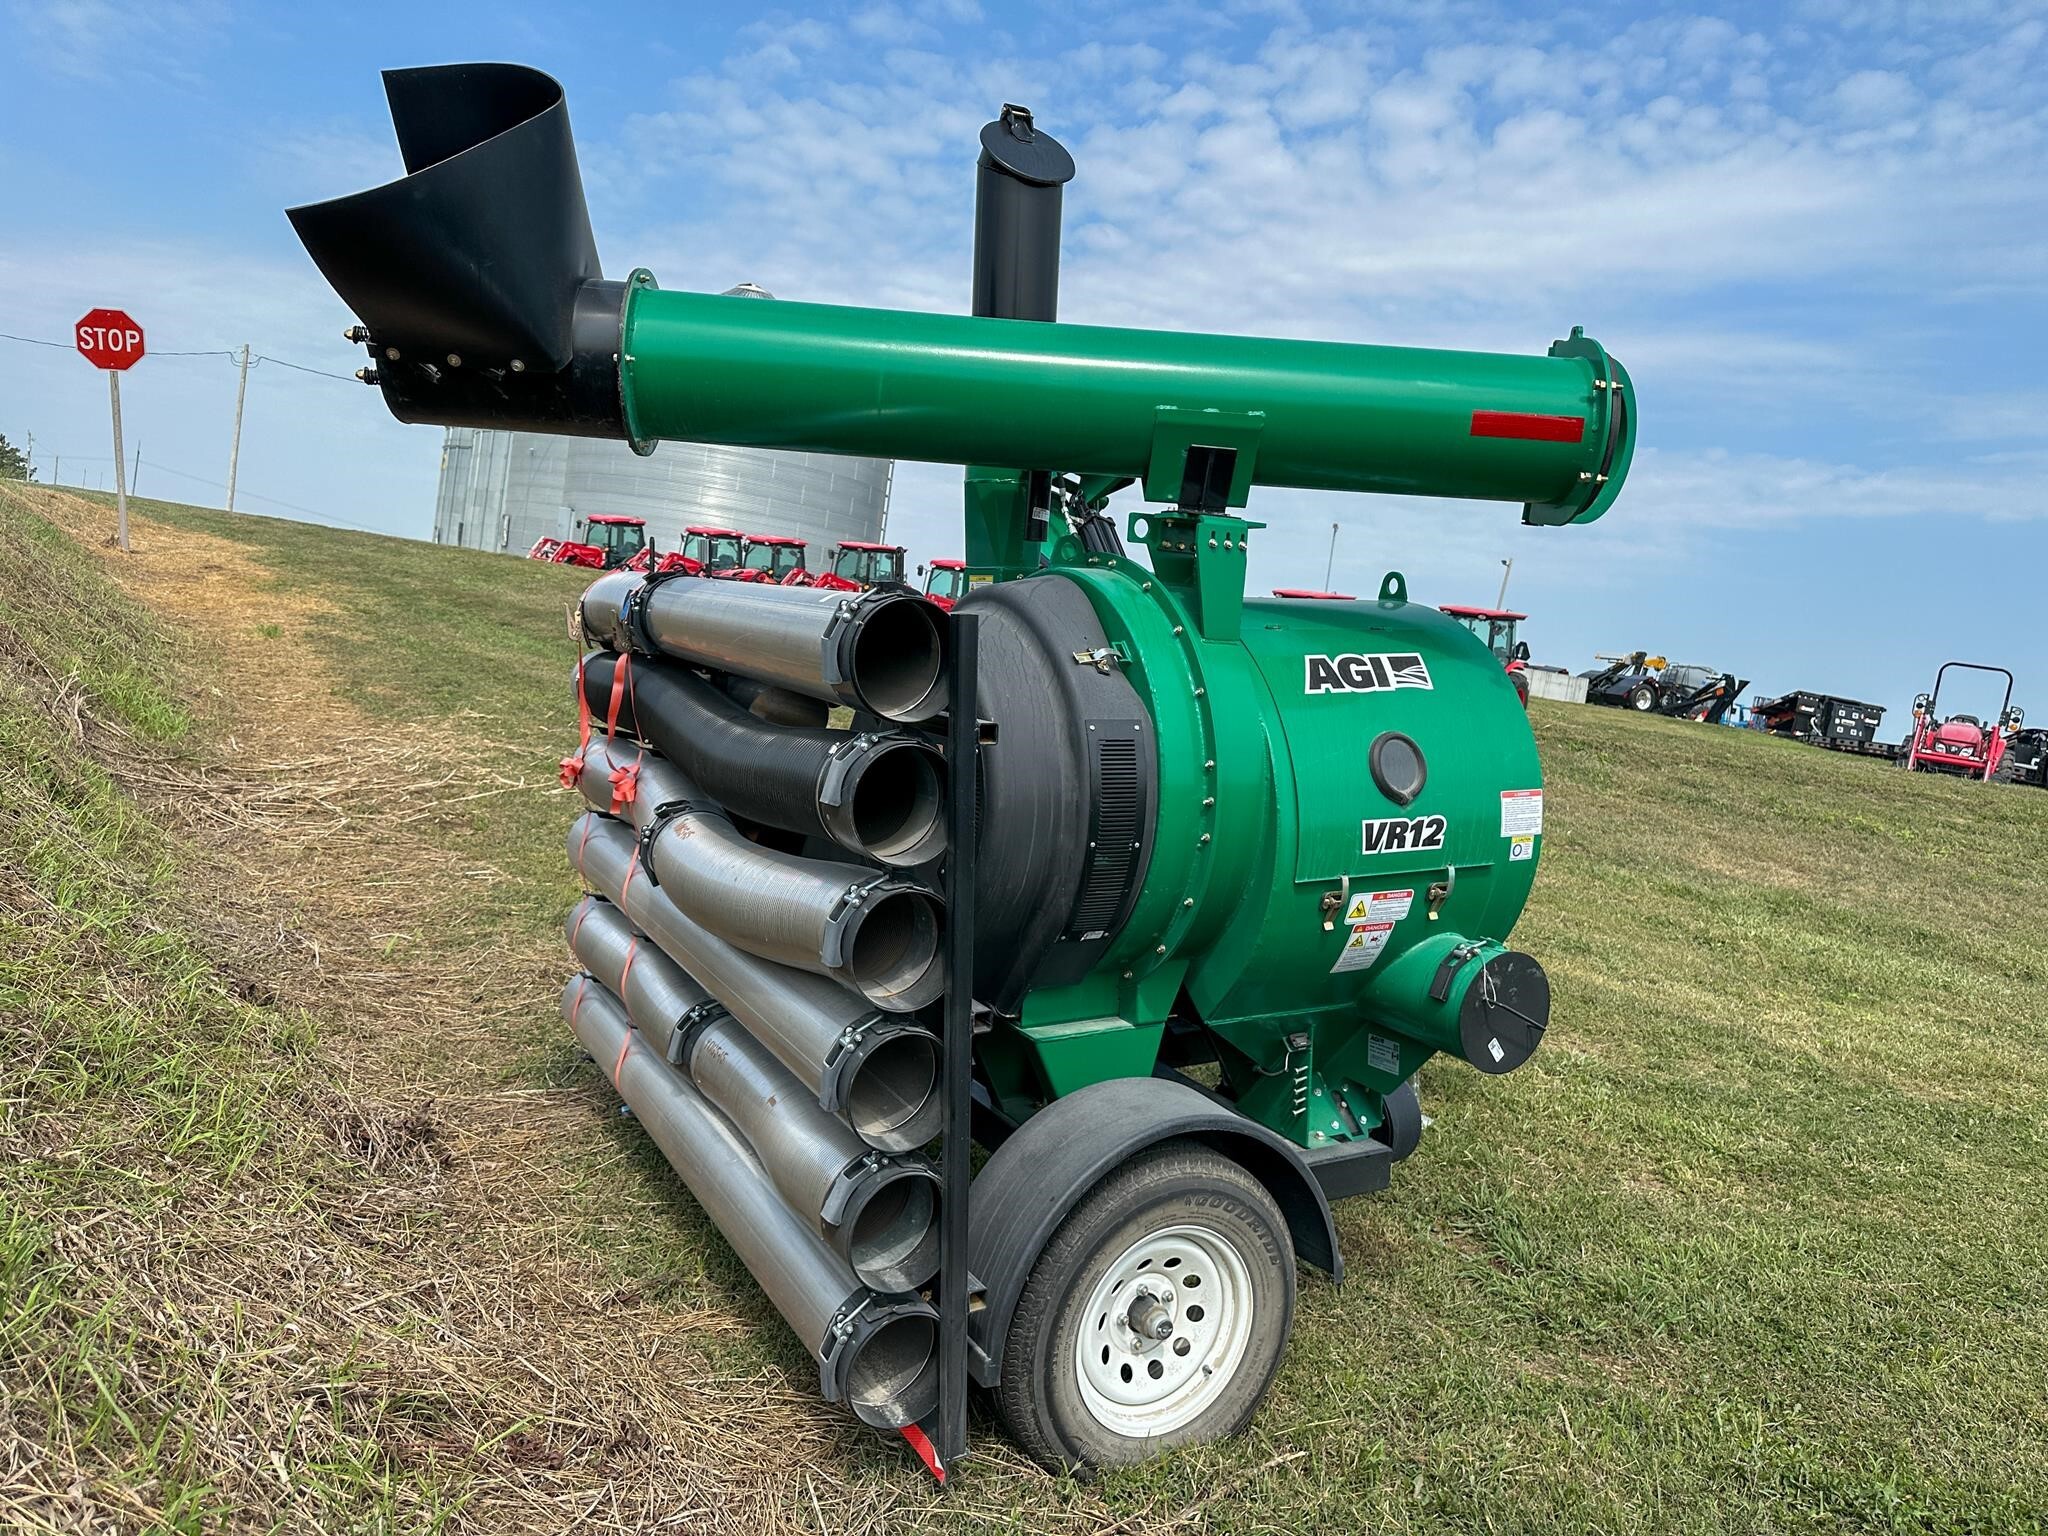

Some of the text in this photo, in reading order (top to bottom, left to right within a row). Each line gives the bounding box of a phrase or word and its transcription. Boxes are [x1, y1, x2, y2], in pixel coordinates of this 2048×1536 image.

[79, 326, 140, 352] STOP
[1308, 656, 1391, 690] AGI
[1365, 818, 1445, 852] VR12
